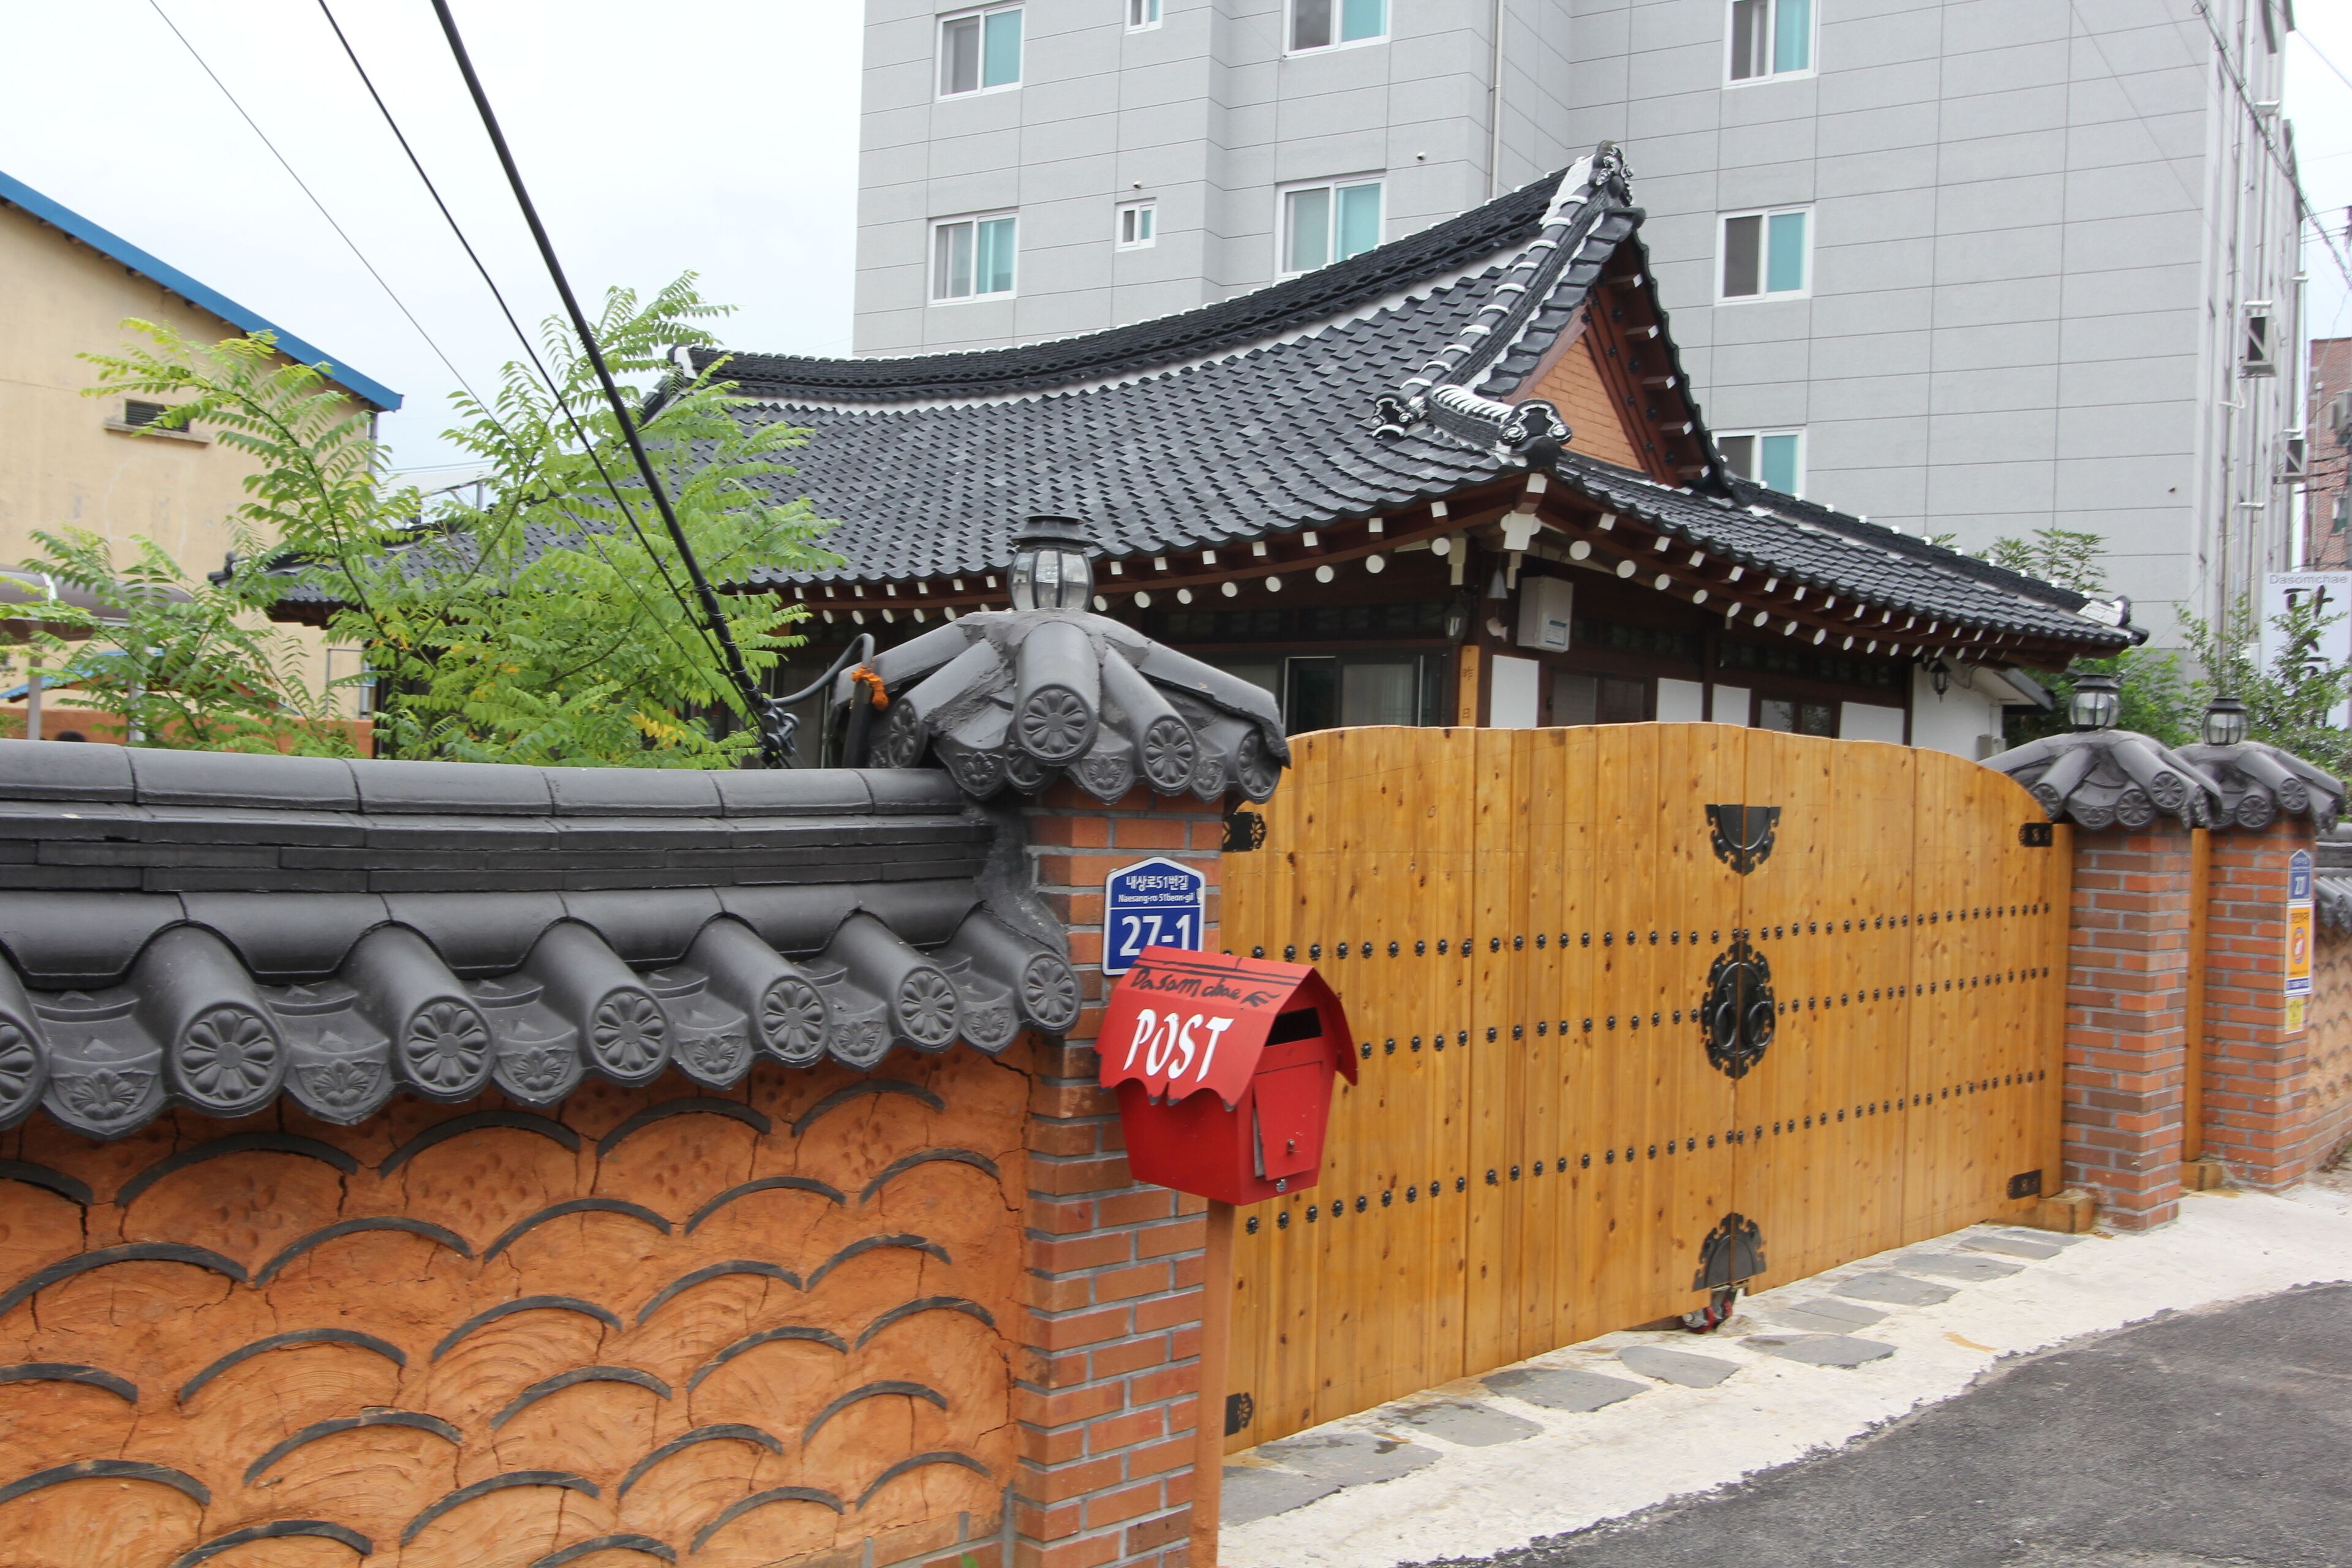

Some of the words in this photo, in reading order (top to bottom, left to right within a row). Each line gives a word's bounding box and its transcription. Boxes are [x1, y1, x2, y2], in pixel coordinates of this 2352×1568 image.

[2269, 575, 2347, 584] Dasomchae
[1126, 875, 1189, 892] 내상로51번길
[1118, 894, 1157, 904] Naesang-ro
[1158, 893, 1194, 903] 51beon-gil
[1120, 914, 1191, 956] 27-1
[1123, 1008, 1234, 1083] POST
